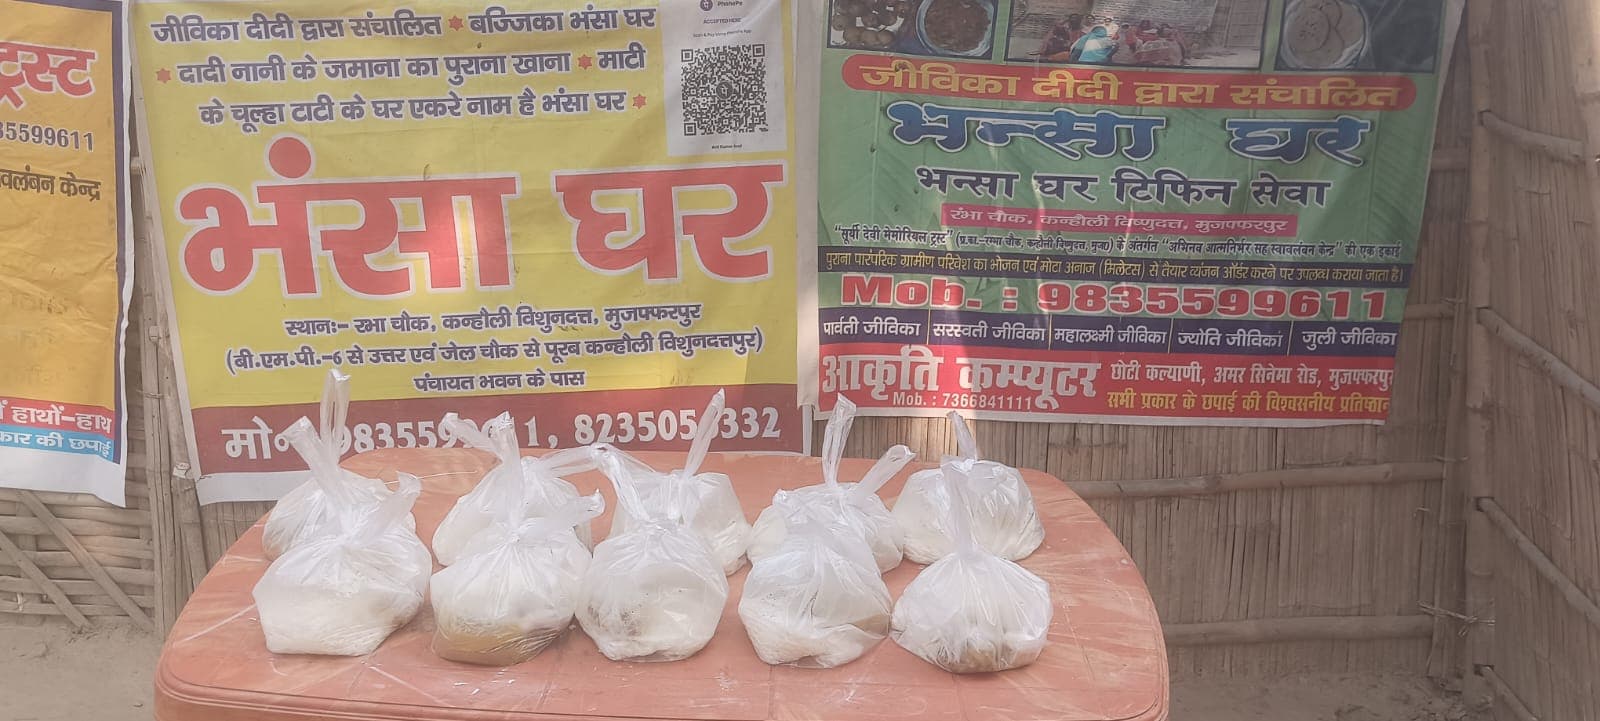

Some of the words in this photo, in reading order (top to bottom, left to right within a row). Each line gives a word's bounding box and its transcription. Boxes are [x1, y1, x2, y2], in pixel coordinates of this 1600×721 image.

[150, 14, 239, 42] जीविका
[245, 12, 293, 40] दीदी
[298, 18, 344, 41] द्वारा
[348, 9, 442, 36] संचालित
[468, 6, 563, 34] बज्जिका
[570, 4, 617, 30] भंसा
[623, 7, 656, 28] घर
[177, 55, 226, 84] दादी
[231, 54, 286, 82] नानी
[291, 54, 317, 80] के
[322, 58, 400, 79] जमाना
[405, 57, 438, 77] का
[444, 55, 506, 86] पुराना
[512, 52, 571, 74] खाना
[597, 41, 646, 70] माटी
[858, 59, 1021, 96] जीविका
[1032, 69, 1123, 101] दीदी
[1134, 81, 1219, 105] द्वारा
[1230, 77, 1402, 106] संचालित
[199, 98, 224, 125] के
[230, 103, 285, 133] चूल्हा
[291, 94, 334, 122] टाटी
[340, 93, 366, 121] के
[371, 99, 404, 119] घर
[408, 91, 462, 119] एकरे
[466, 96, 512, 116] नाम
[517, 87, 536, 116] है
[542, 87, 589, 113] भंसा
[594, 91, 627, 111] घर
[886, 100, 1166, 161] भन्सा
[1225, 114, 1371, 167] घर
[60, 172, 101, 202] केन्द्र
[915, 166, 1019, 199] भन्सा
[1032, 172, 1098, 202] घर
[1110, 166, 1238, 208] टिफिन
[1250, 170, 1332, 208] सेवा
[178, 136, 517, 296] भंसा
[554, 164, 785, 283] घर
[950, 206, 983, 221] रंभा
[1040, 213, 1109, 228] कन्हौली
[863, 225, 881, 241] देवी
[883, 226, 928, 243] मेमोरियल
[1116, 238, 1127, 251] के
[1129, 237, 1159, 253] अंतर्गत
[1206, 238, 1251, 255] आत्मनिर्भर
[1254, 243, 1268, 256] सह
[1271, 241, 1316, 257] स्वावलंबन
[1345, 241, 1356, 257] की
[1359, 244, 1376, 259] एक
[826, 252, 851, 270] पुराना
[855, 248, 898, 266] पारंपरिक
[900, 251, 935, 269] ग्रामीण
[938, 252, 970, 271] परिवेश
[973, 257, 987, 271] का
[990, 255, 1020, 272] भोजन
[1023, 256, 1039, 273] एवं
[1040, 257, 1062, 273] मोटा
[1065, 261, 1096, 274] अनाज
[1149, 260, 1159, 278] से
[1161, 260, 1188, 278] तैयार
[1190, 262, 1219, 279] व्यंजन
[1223, 262, 1249, 279] ऑर्डर
[1251, 263, 1276, 281] करने
[1279, 267, 1293, 281] पर
[1296, 268, 1329, 281] उपलब्ध
[1332, 268, 1362, 281] कराया
[1365, 269, 1389, 282] जाता
[841, 272, 982, 310] Mob.
[1037, 282, 1386, 320] 9835599611
[354, 317, 386, 333] रभा
[391, 310, 436, 333] चौक,
[441, 306, 512, 330] कन्हौली
[516, 305, 598, 333] विशुनदत्त,
[823, 315, 859, 336] पार्वती
[863, 318, 920, 337] जीविका
[933, 320, 987, 338] सरस्वती
[992, 322, 1045, 342] जीविका
[1054, 324, 1115, 344] महालक्ष्मी
[1117, 325, 1168, 344] जीविका
[346, 344, 364, 365] से
[368, 348, 407, 364] उत्तर
[410, 342, 438, 362] एवं
[440, 341, 476, 361] जेल
[479, 338, 518, 359] चौक
[523, 338, 540, 358] से
[545, 341, 580, 364] पूरब
[584, 332, 653, 355] कन्हौली
[657, 327, 763, 357] विशुनदत्तपुर)
[1177, 326, 1222, 347] ज्योति
[1302, 326, 1336, 350] जुली
[1340, 327, 1397, 347] जीविका
[414, 372, 475, 392] पंचायत
[479, 371, 522, 390] भवन
[526, 368, 545, 388] के
[550, 370, 585, 387] पास
[822, 344, 944, 401] आकृति
[956, 356, 1101, 410] कम्प्यूटर
[1110, 359, 1141, 381] छोटी
[1145, 360, 1206, 386] कल्याणी,
[1213, 365, 1244, 384] अमर
[1250, 362, 1292, 385] सिनेमा
[1297, 363, 1321, 388] रोड,
[893, 393, 927, 407] Mob.
[943, 393, 1032, 409] 7366841111
[1107, 387, 1135, 409] सभी
[1141, 391, 1177, 410] प्रकार
[1182, 389, 1196, 410] के
[1201, 390, 1235, 413] छपाई
[1242, 391, 1261, 411] की
[1266, 391, 1335, 412] विश्वसनीय
[574, 407, 781, 445] 823505332
[35, 431, 64, 448] की
[68, 438, 112, 458] छपाई
